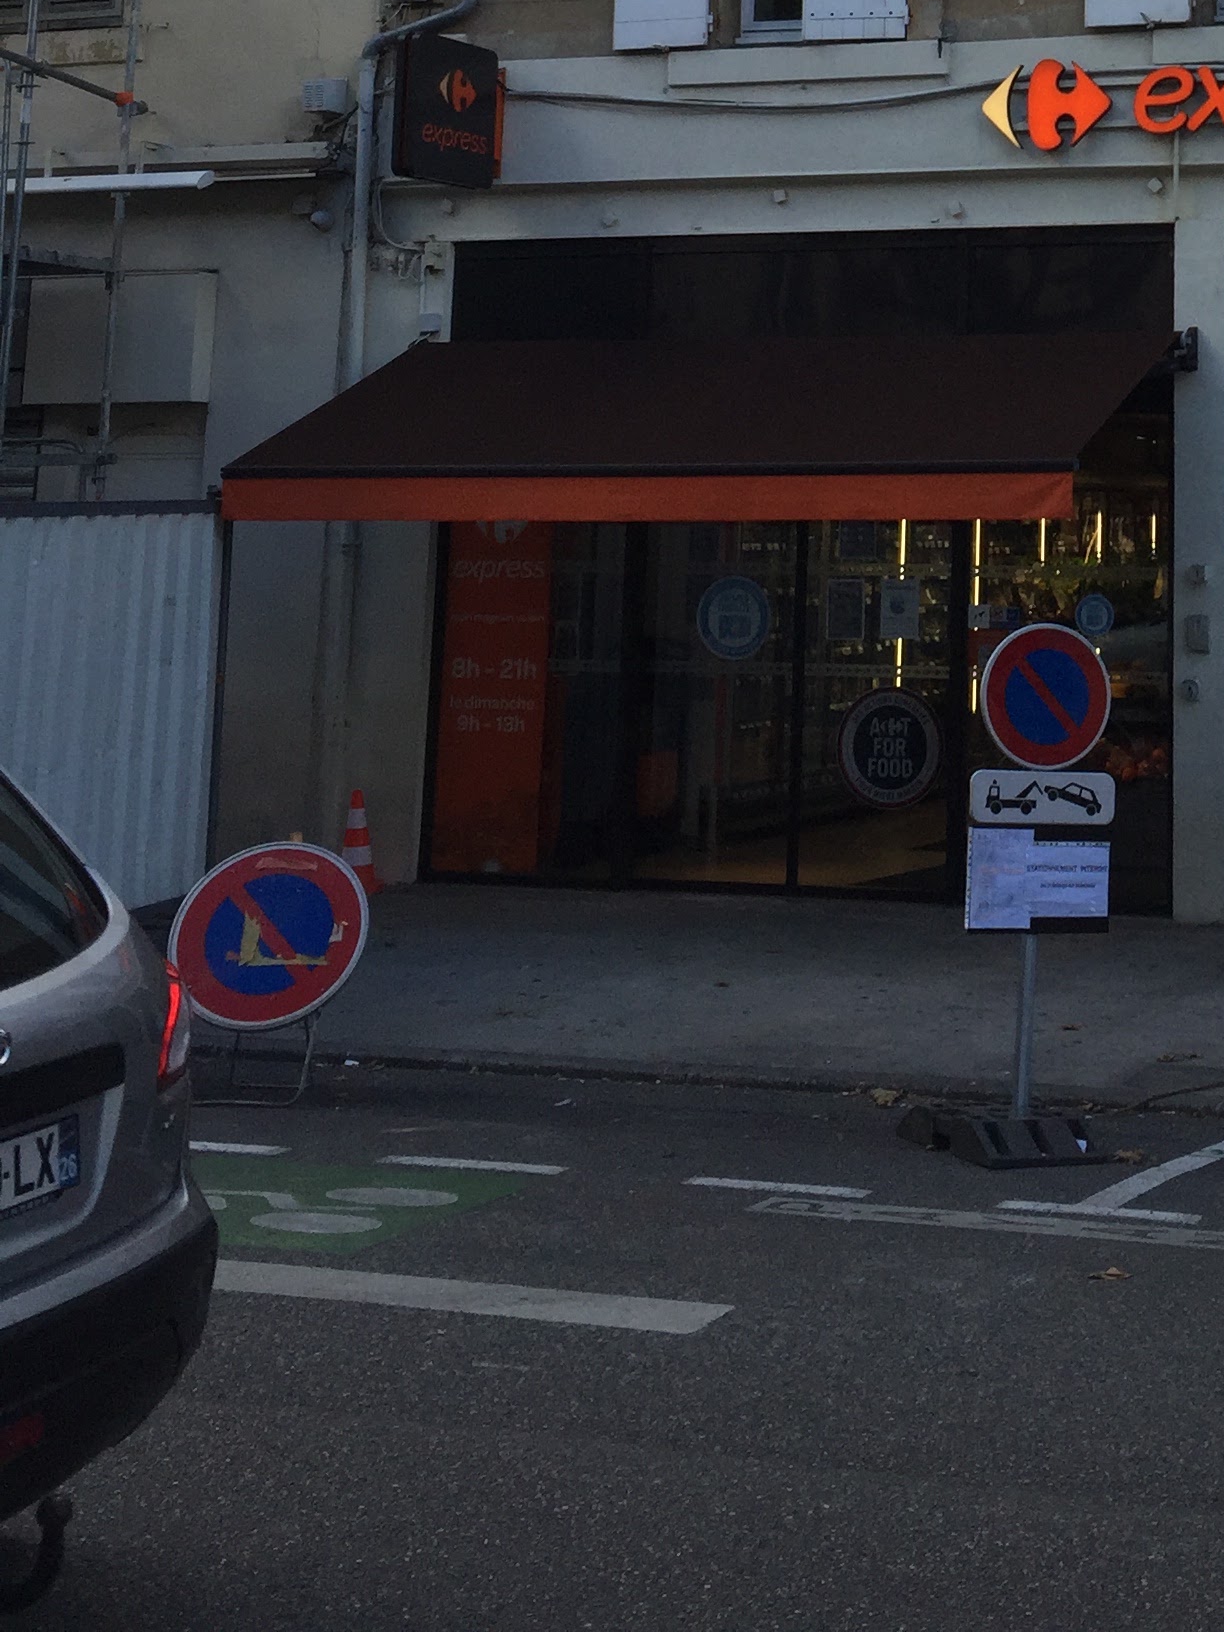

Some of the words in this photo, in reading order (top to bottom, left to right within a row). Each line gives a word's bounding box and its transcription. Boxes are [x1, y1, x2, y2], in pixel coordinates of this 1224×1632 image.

[421, 123, 488, 155] express
[452, 558, 546, 583] express
[452, 657, 481, 679] 8h
[500, 658, 538, 680] 21h
[873, 737, 907, 757] FOR
[867, 757, 914, 779] FOOD
[59, 1153, 78, 1180] 26
